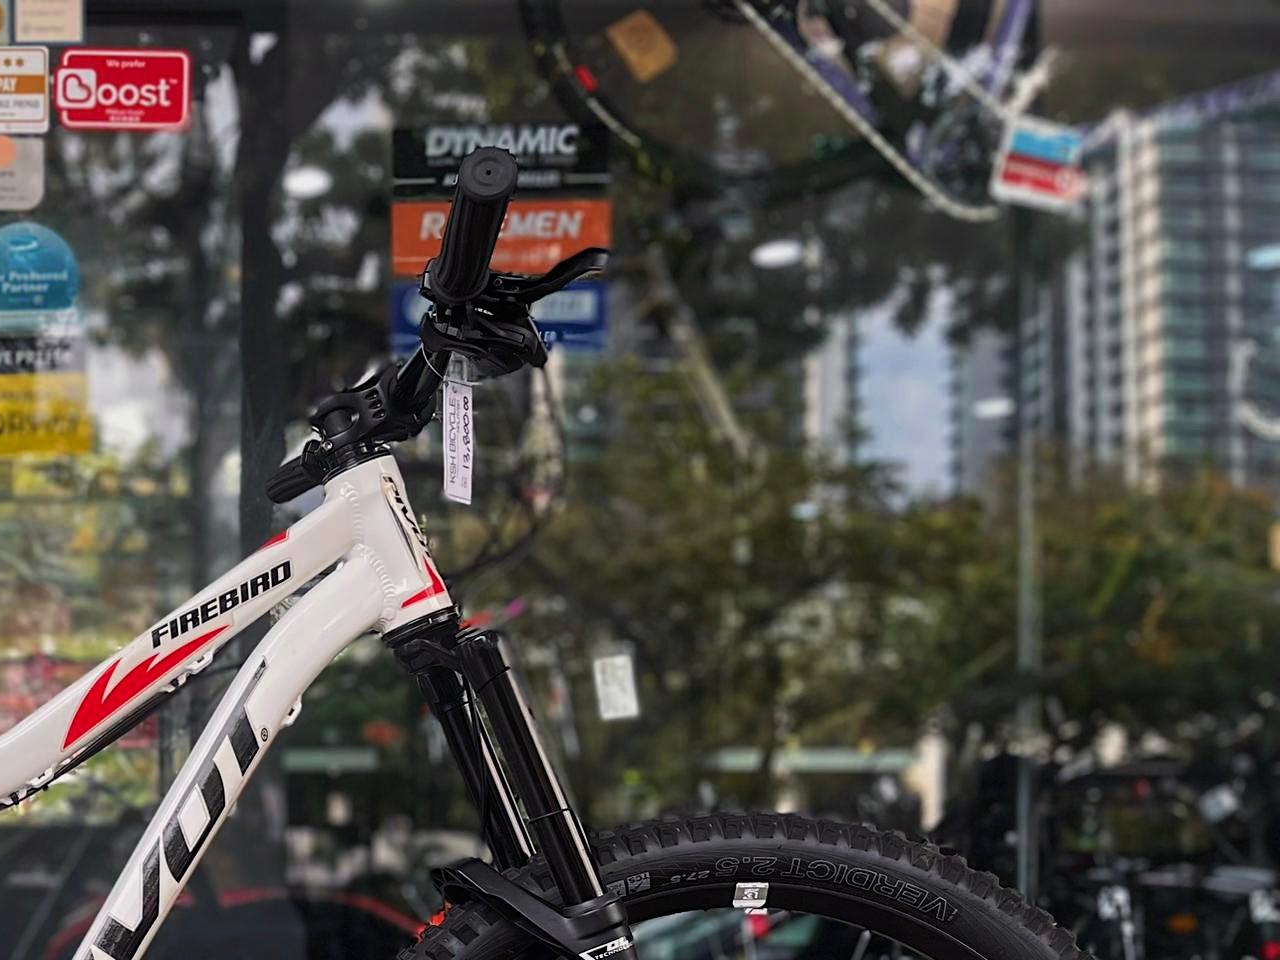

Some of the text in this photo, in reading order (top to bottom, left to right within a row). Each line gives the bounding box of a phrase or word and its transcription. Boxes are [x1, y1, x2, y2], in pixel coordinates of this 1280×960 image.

[424, 124, 579, 156] DYNAMIC
[151, 559, 292, 648] FIREBIRD
[715, 856, 777, 877] 2.5
[781, 857, 948, 921] VERDICT
